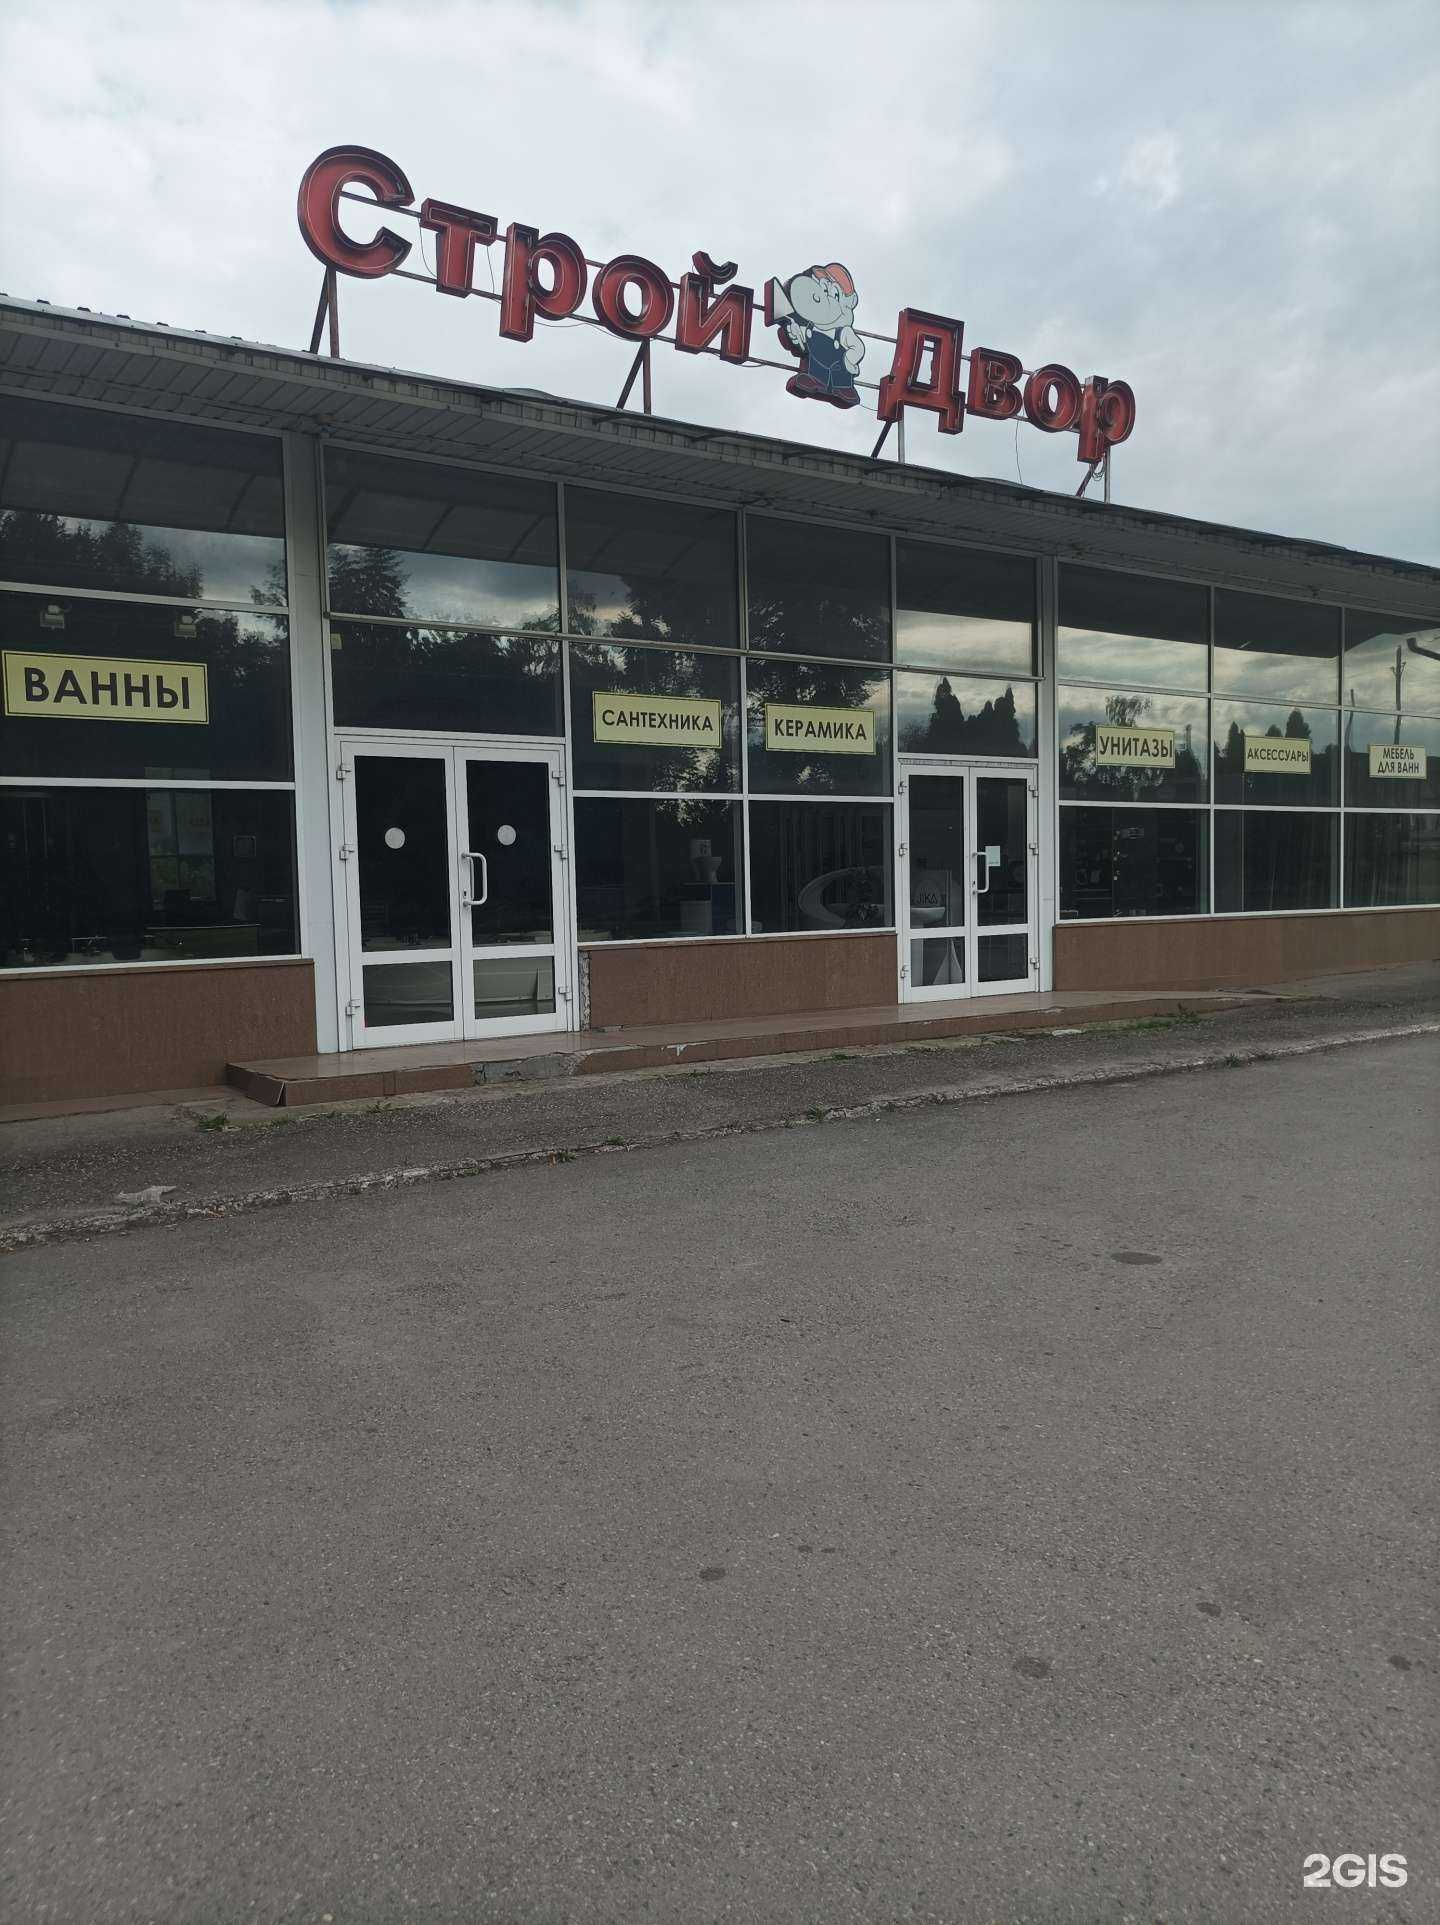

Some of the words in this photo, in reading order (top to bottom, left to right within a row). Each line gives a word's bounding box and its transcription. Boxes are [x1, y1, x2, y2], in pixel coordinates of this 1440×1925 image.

[297, 144, 754, 366] Строй
[877, 307, 1136, 464] Двор
[24, 666, 191, 710] ВАННЫ
[601, 709, 714, 732] САНТЕХНИКА
[774, 718, 867, 740] КЕРАМИКА
[1099, 735, 1173, 758] УНИТАЗЫ
[1247, 747, 1309, 762] АКСЕССУАРЫ
[1382, 747, 1415, 760] МЕБЕЛЬ
[1377, 761, 1395, 774] ДЛЯ
[1397, 761, 1420, 774] ВАНН
